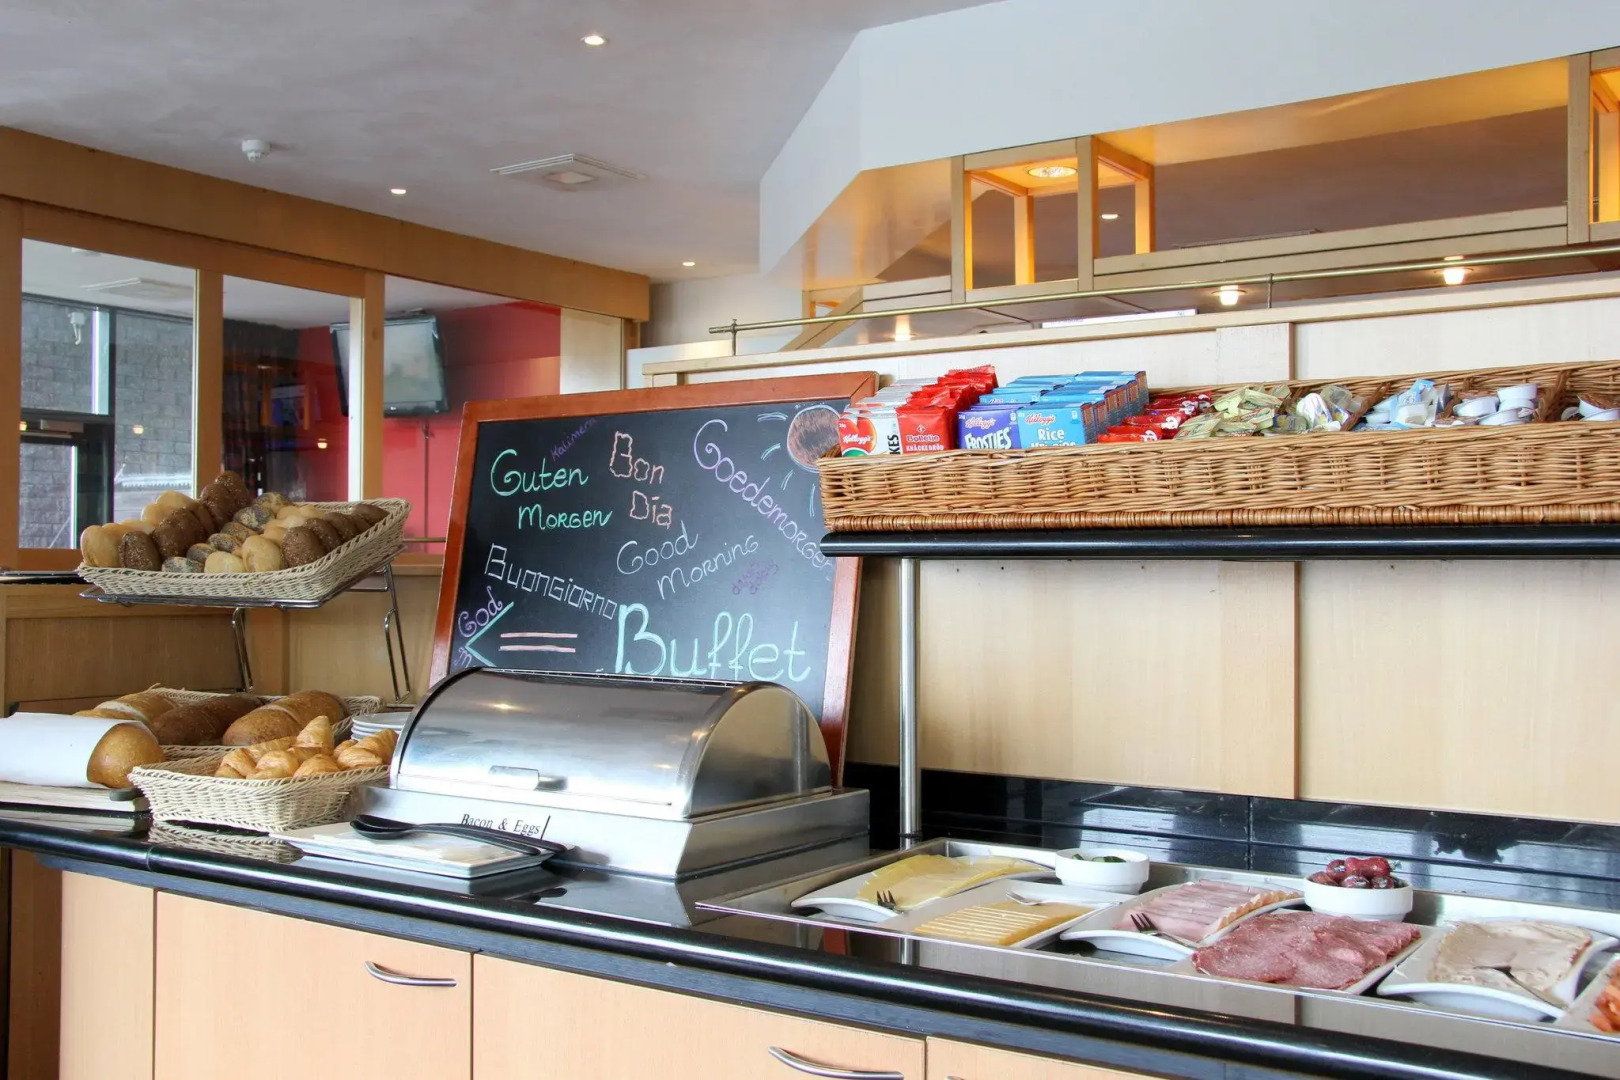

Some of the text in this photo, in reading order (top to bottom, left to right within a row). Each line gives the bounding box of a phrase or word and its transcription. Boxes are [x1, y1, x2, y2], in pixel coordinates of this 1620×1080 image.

[609, 430, 665, 485] Bon
[964, 426, 1012, 450] FROSTIES
[1037, 427, 1065, 441] Rice
[490, 448, 589, 497] Guten
[616, 519, 700, 575] Good
[457, 585, 503, 638] God
[615, 603, 812, 682] Buffet
[460, 813, 541, 836] Bacon & Eggs
